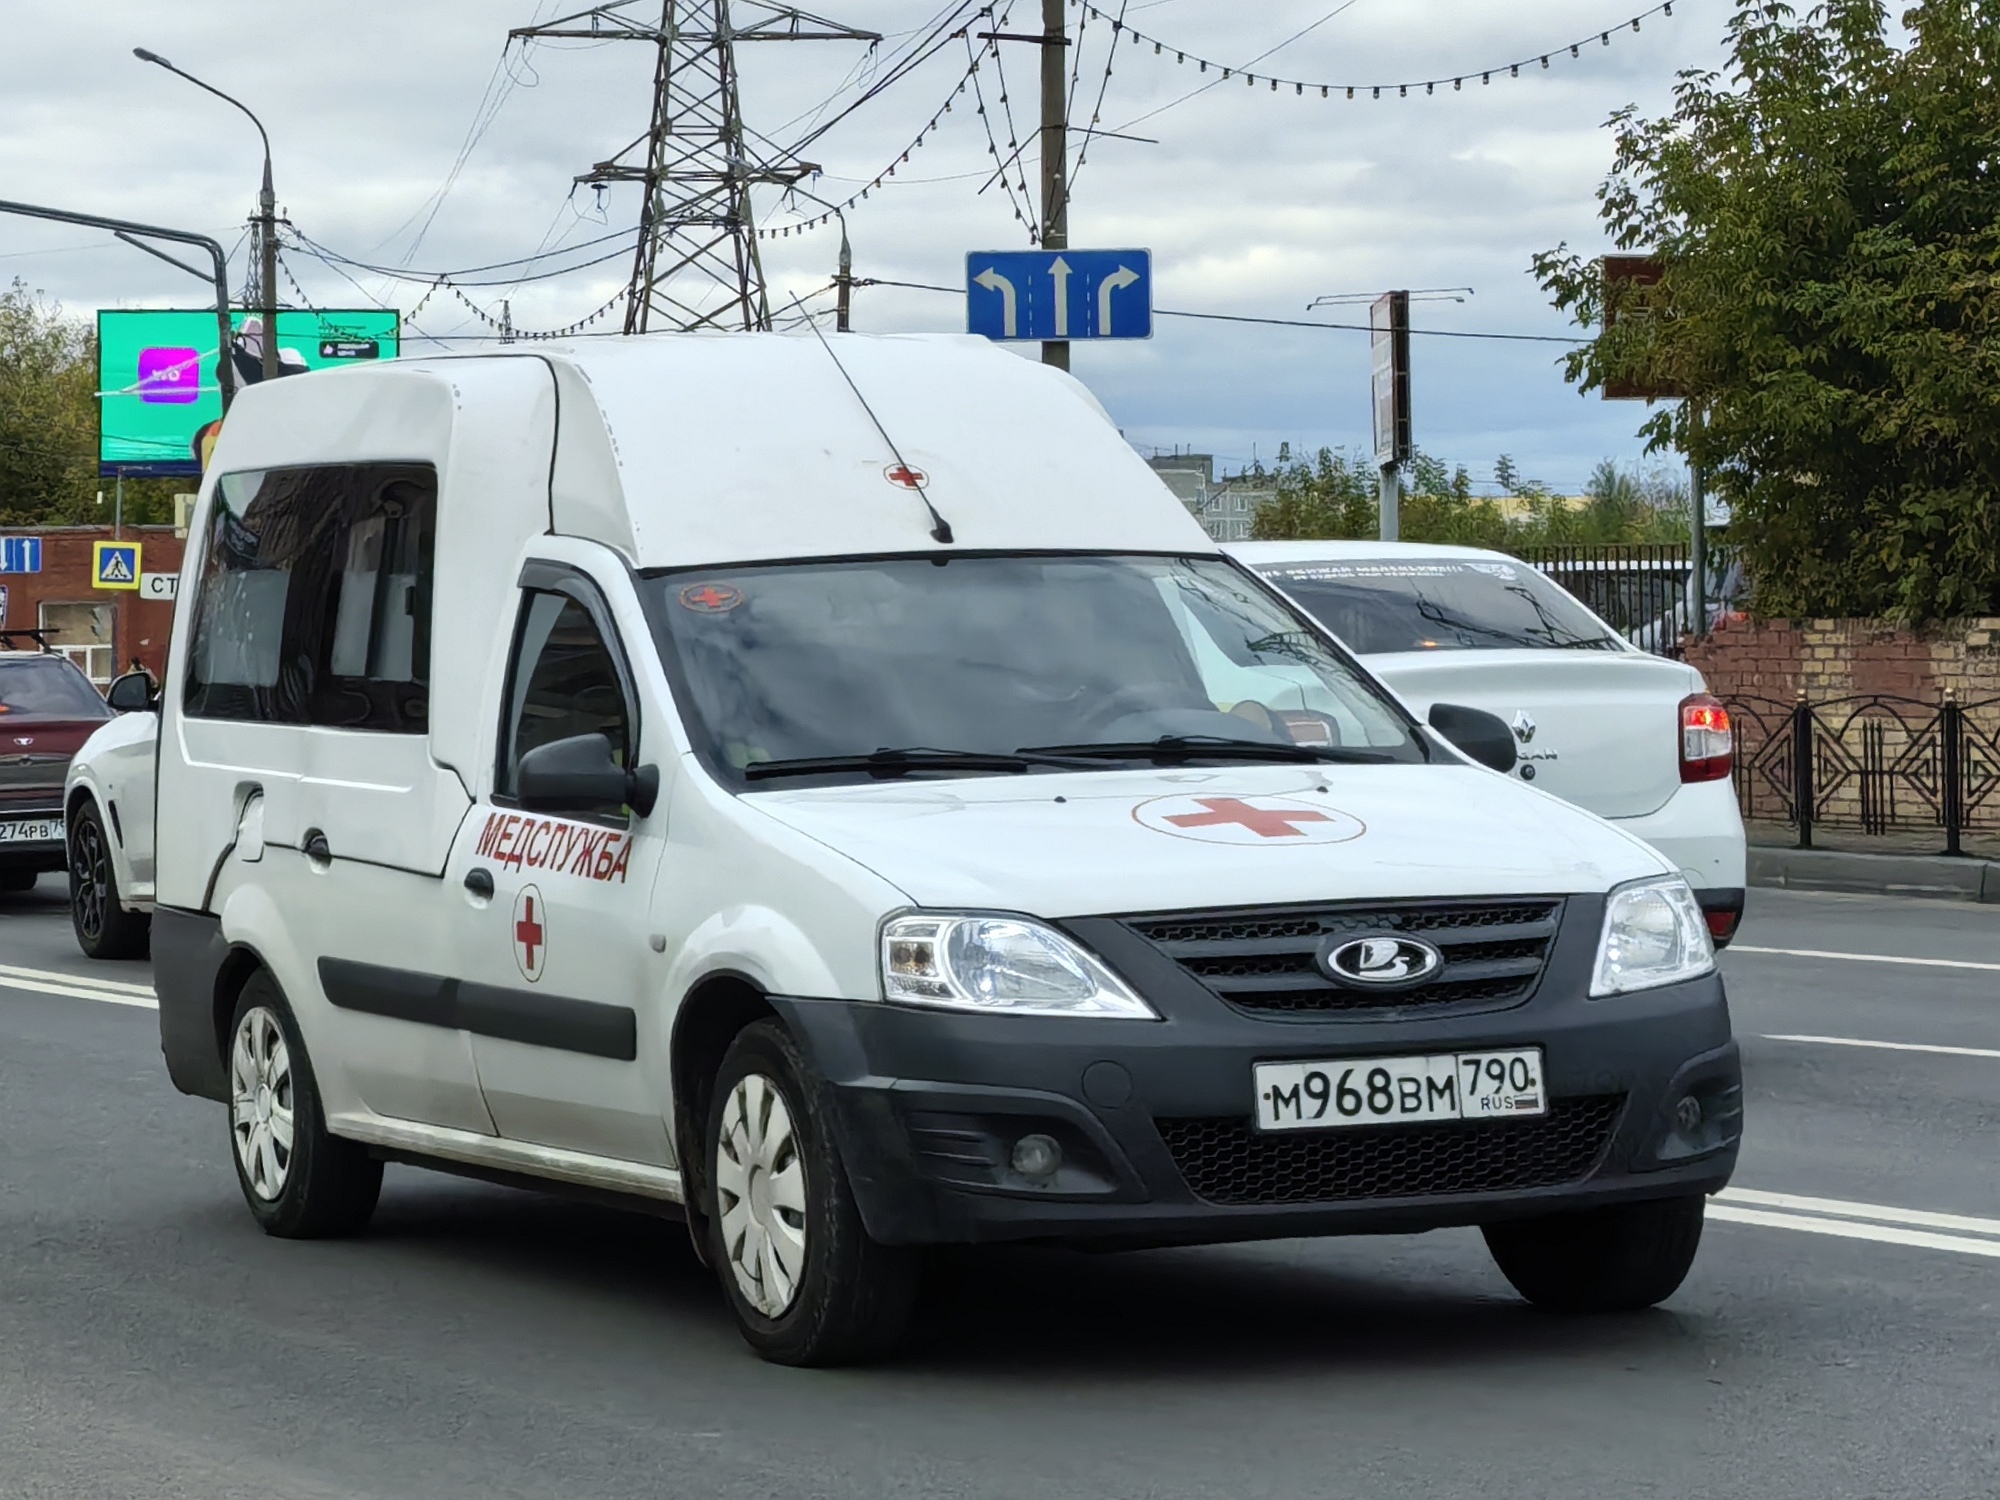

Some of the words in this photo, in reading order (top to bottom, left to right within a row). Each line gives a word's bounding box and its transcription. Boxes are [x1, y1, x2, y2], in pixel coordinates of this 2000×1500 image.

[475, 812, 634, 884] МЕДСЛУЖБА
[1271, 1067, 1456, 1121] М968ВМ
[1462, 1056, 1530, 1096] 790
[1480, 1094, 1514, 1110] RUS
